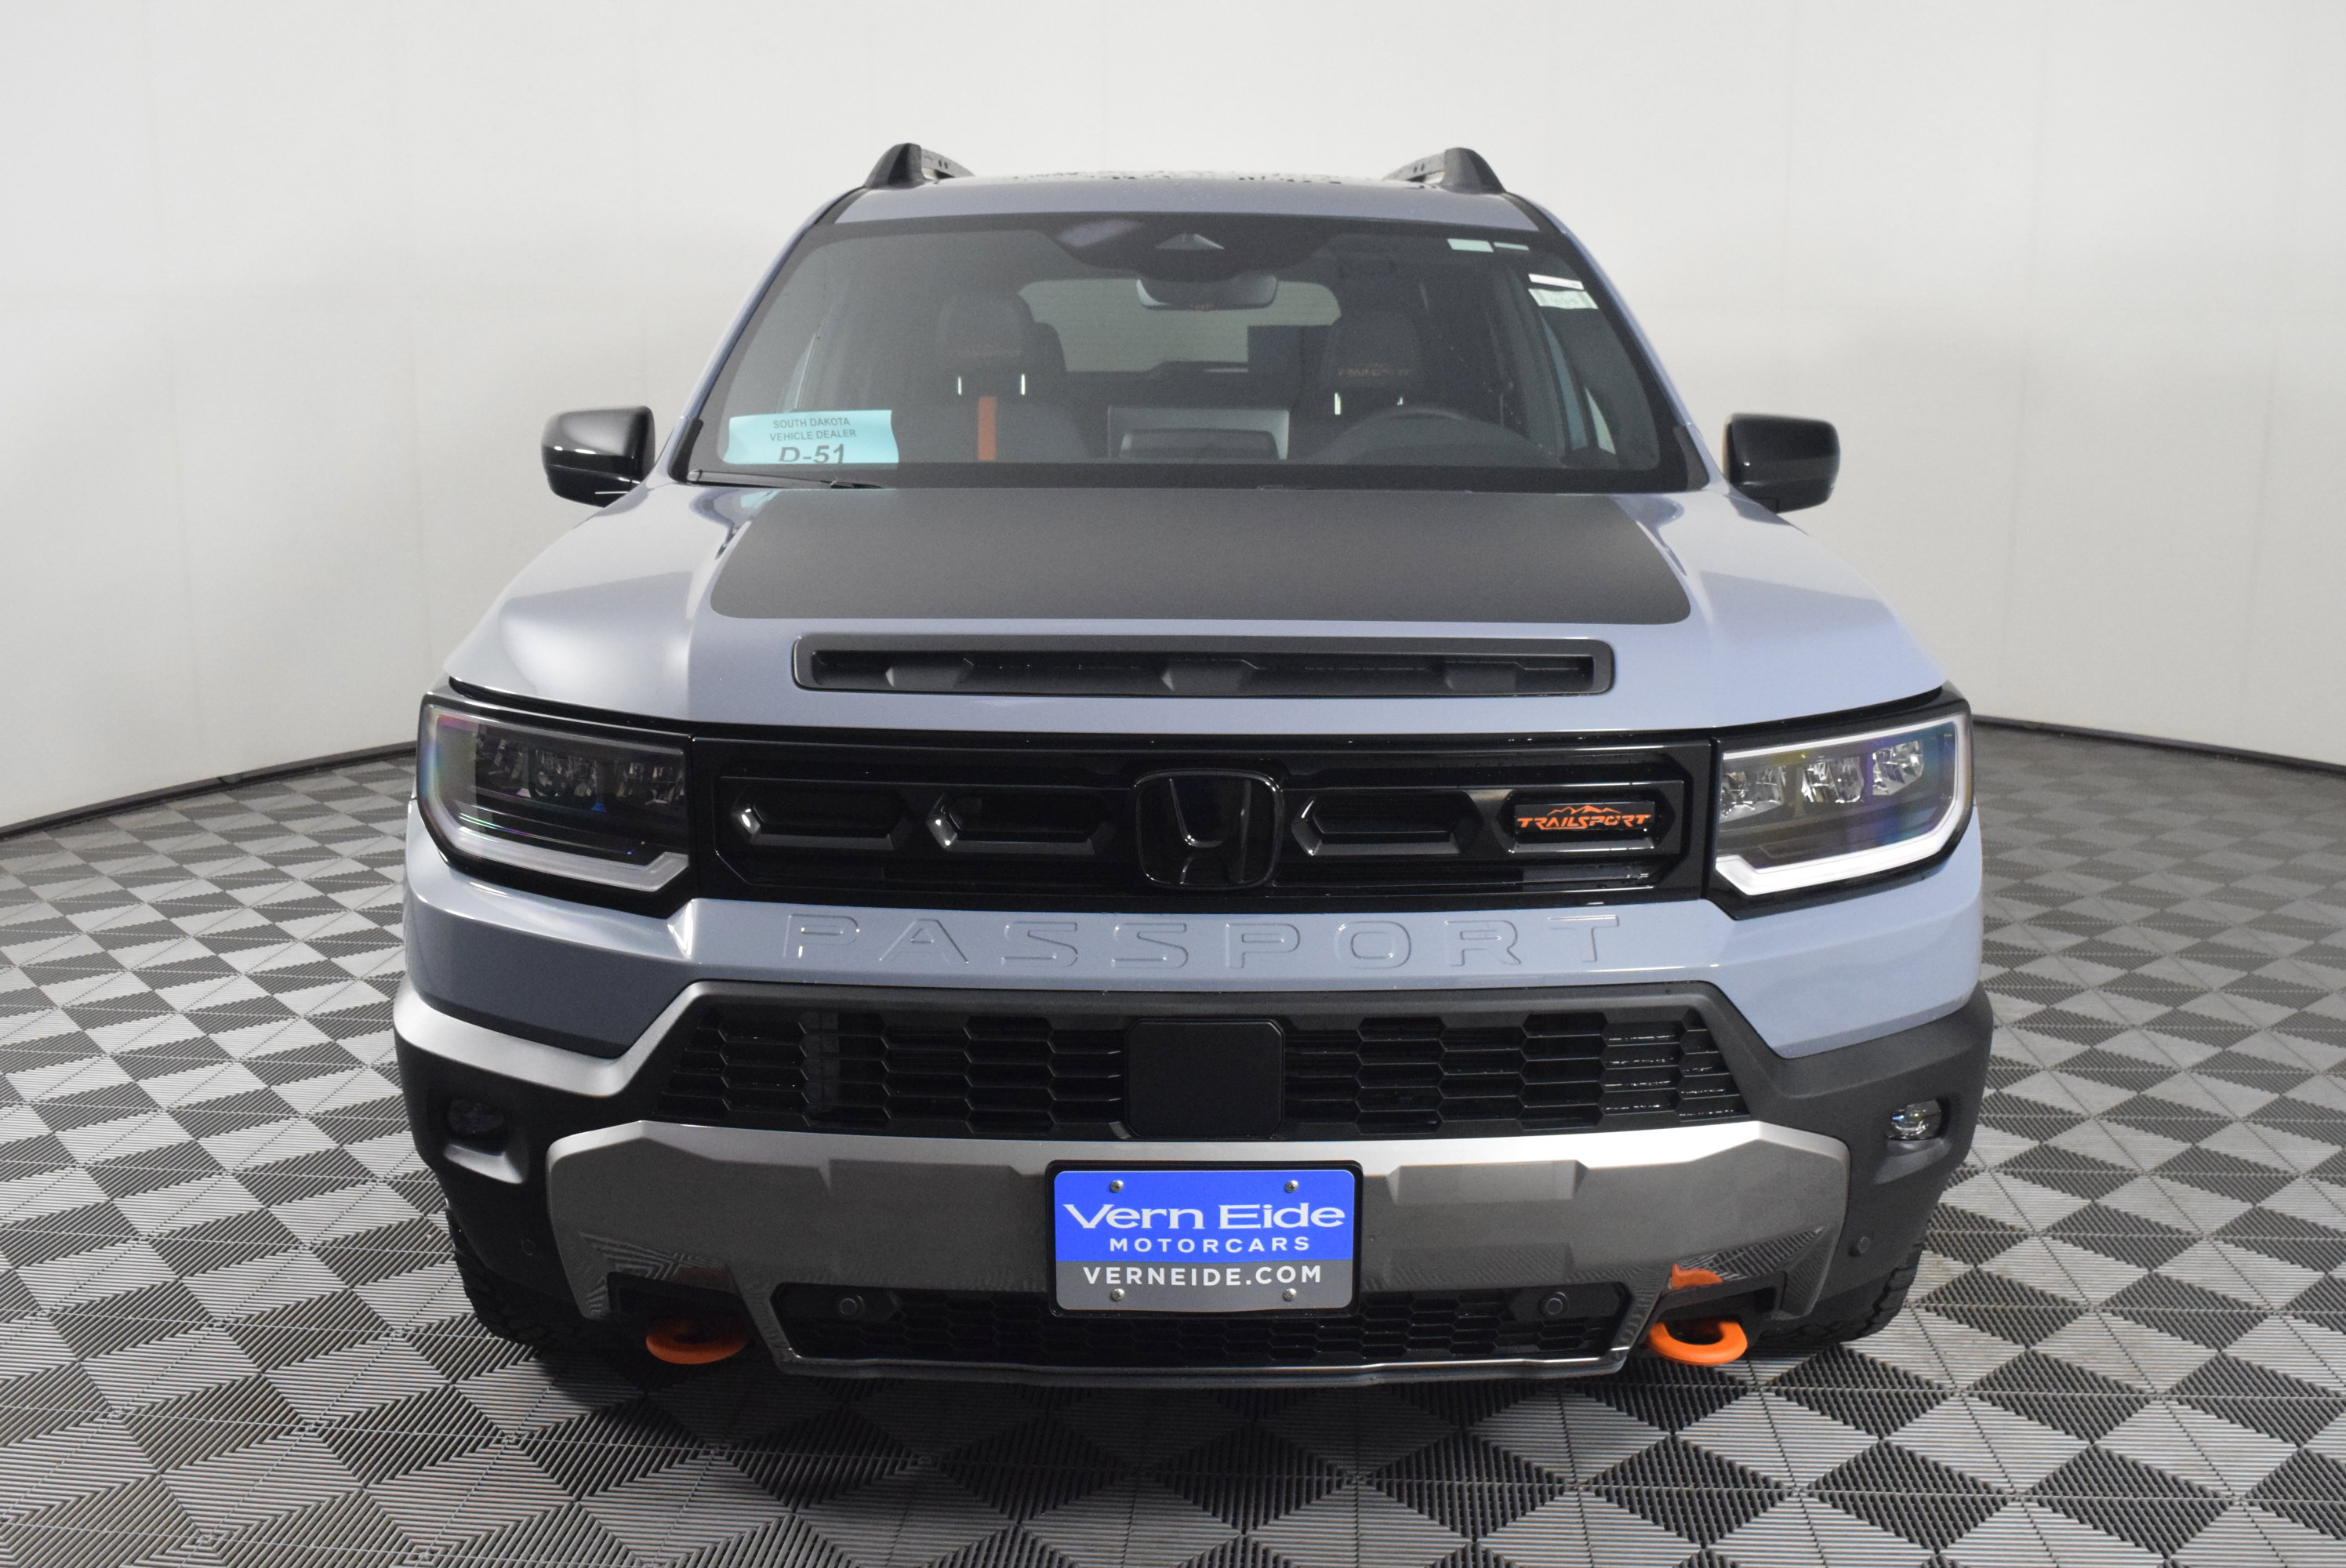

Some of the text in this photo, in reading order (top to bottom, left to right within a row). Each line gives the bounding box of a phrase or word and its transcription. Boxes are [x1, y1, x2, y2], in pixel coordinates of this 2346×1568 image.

[773, 417, 850, 429] SOUTH DAKOTA
[770, 429, 857, 441] VEHICLE DEALER
[779, 444, 844, 464] D-51
[1516, 814, 1651, 829] TRAILSPORT
[785, 913, 1619, 968] PASSPORT
[1063, 1203, 1346, 1229] Vern Eide
[1109, 1236, 1309, 1253] MOTORCARS
[1083, 1265, 1321, 1287] VERNEIDE.COM
